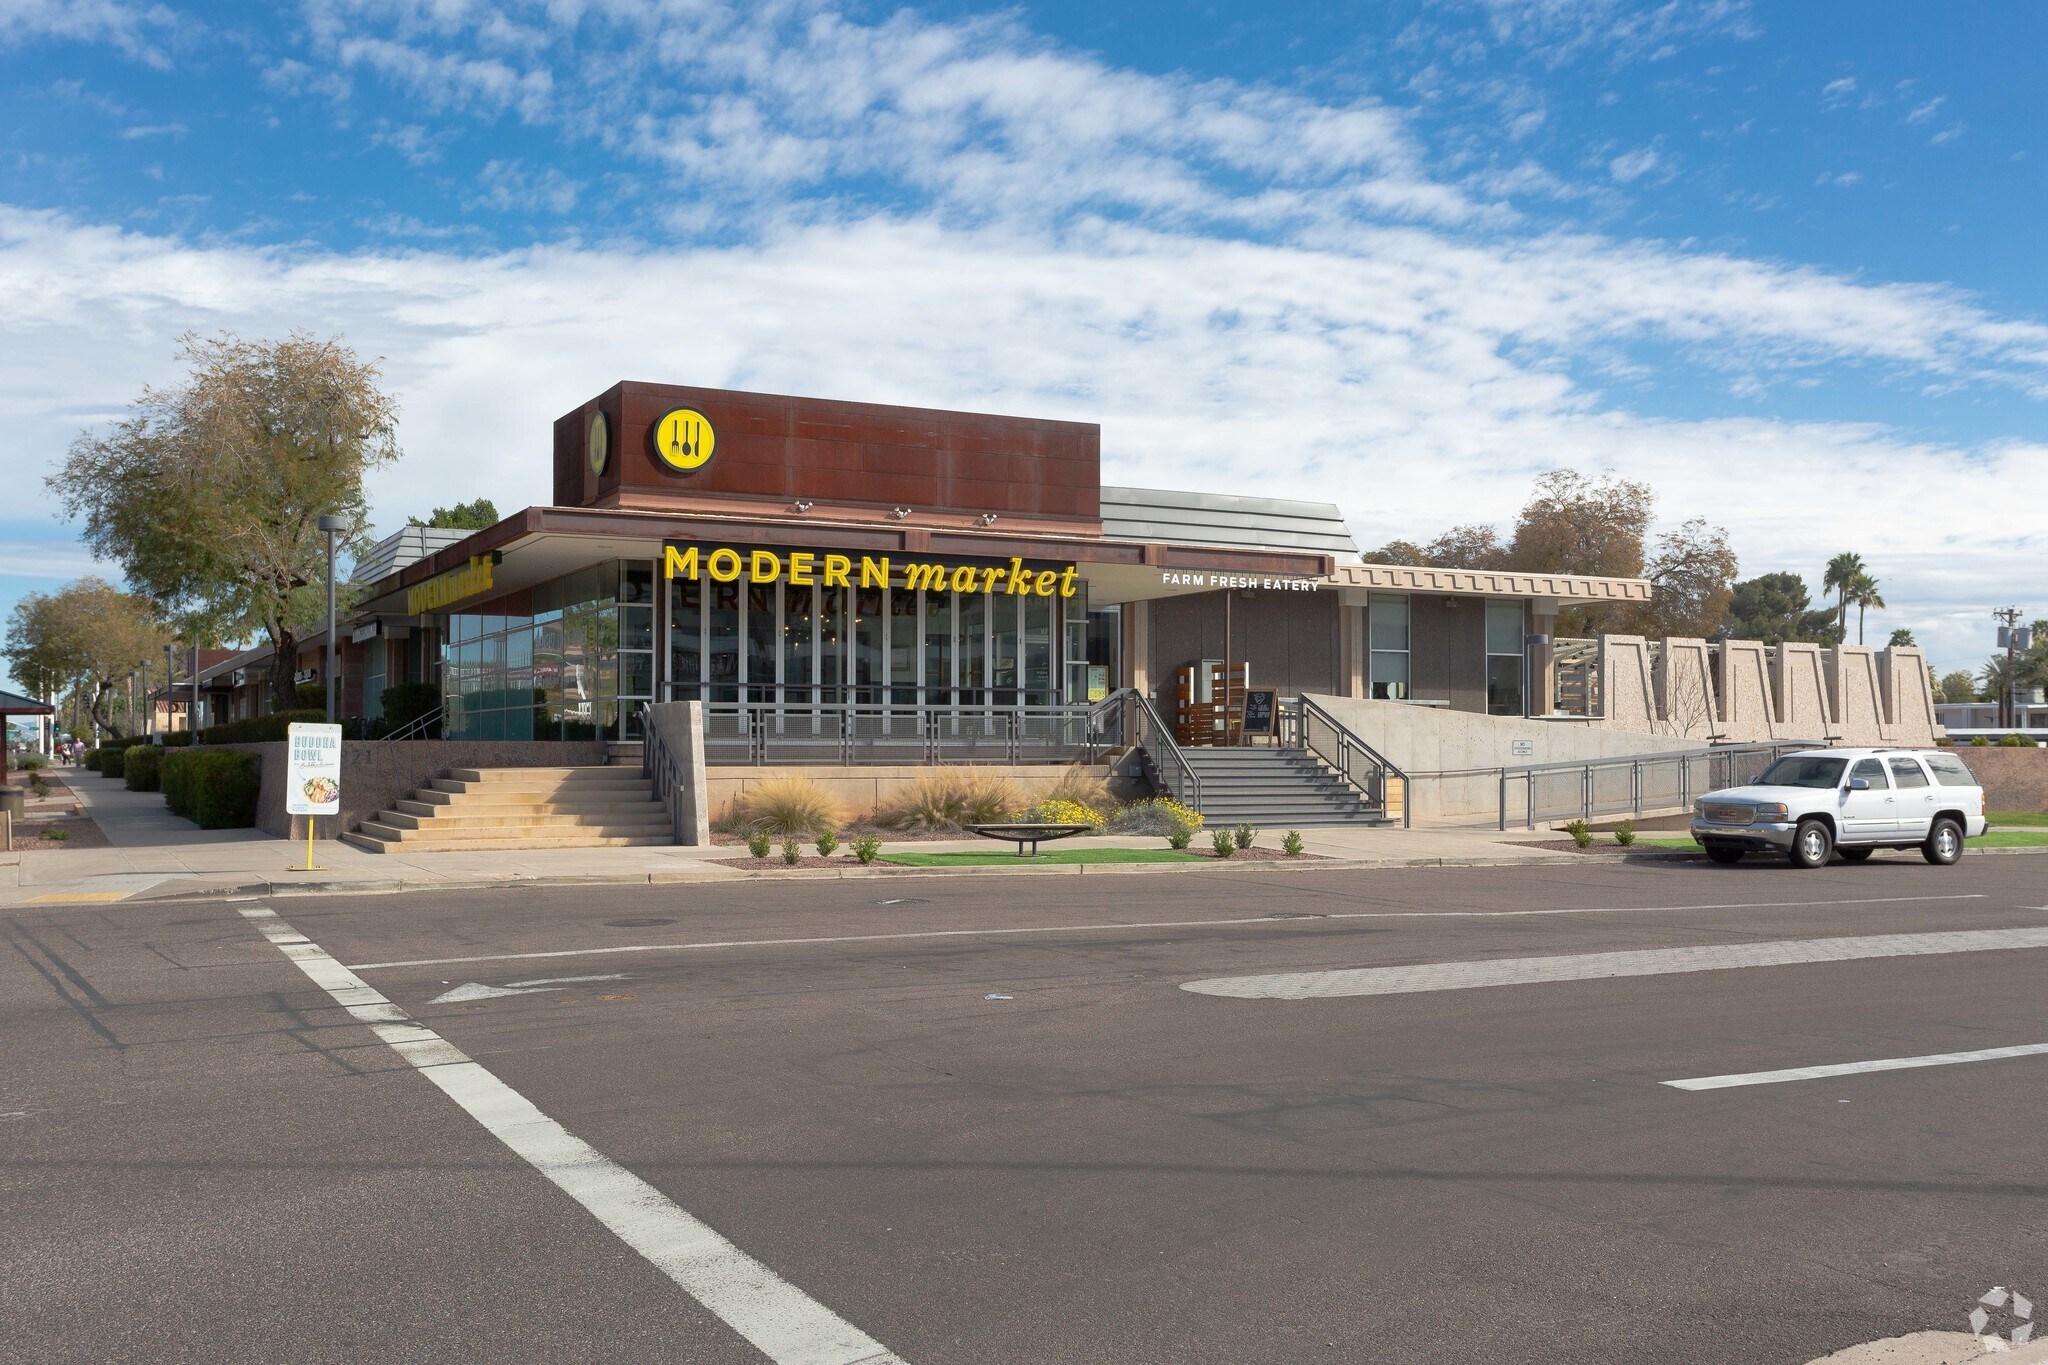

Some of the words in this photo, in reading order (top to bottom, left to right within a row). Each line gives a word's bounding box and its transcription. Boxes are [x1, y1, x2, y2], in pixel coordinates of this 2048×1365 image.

[664, 545, 889, 589] MODERN
[904, 557, 1079, 598] market
[1162, 573, 1204, 586] FARM
[1210, 575, 1257, 589] FRESH
[1264, 578, 1319, 592] EATERY
[294, 736, 336, 749] BUDDHA
[294, 749, 323, 761] BOWL
